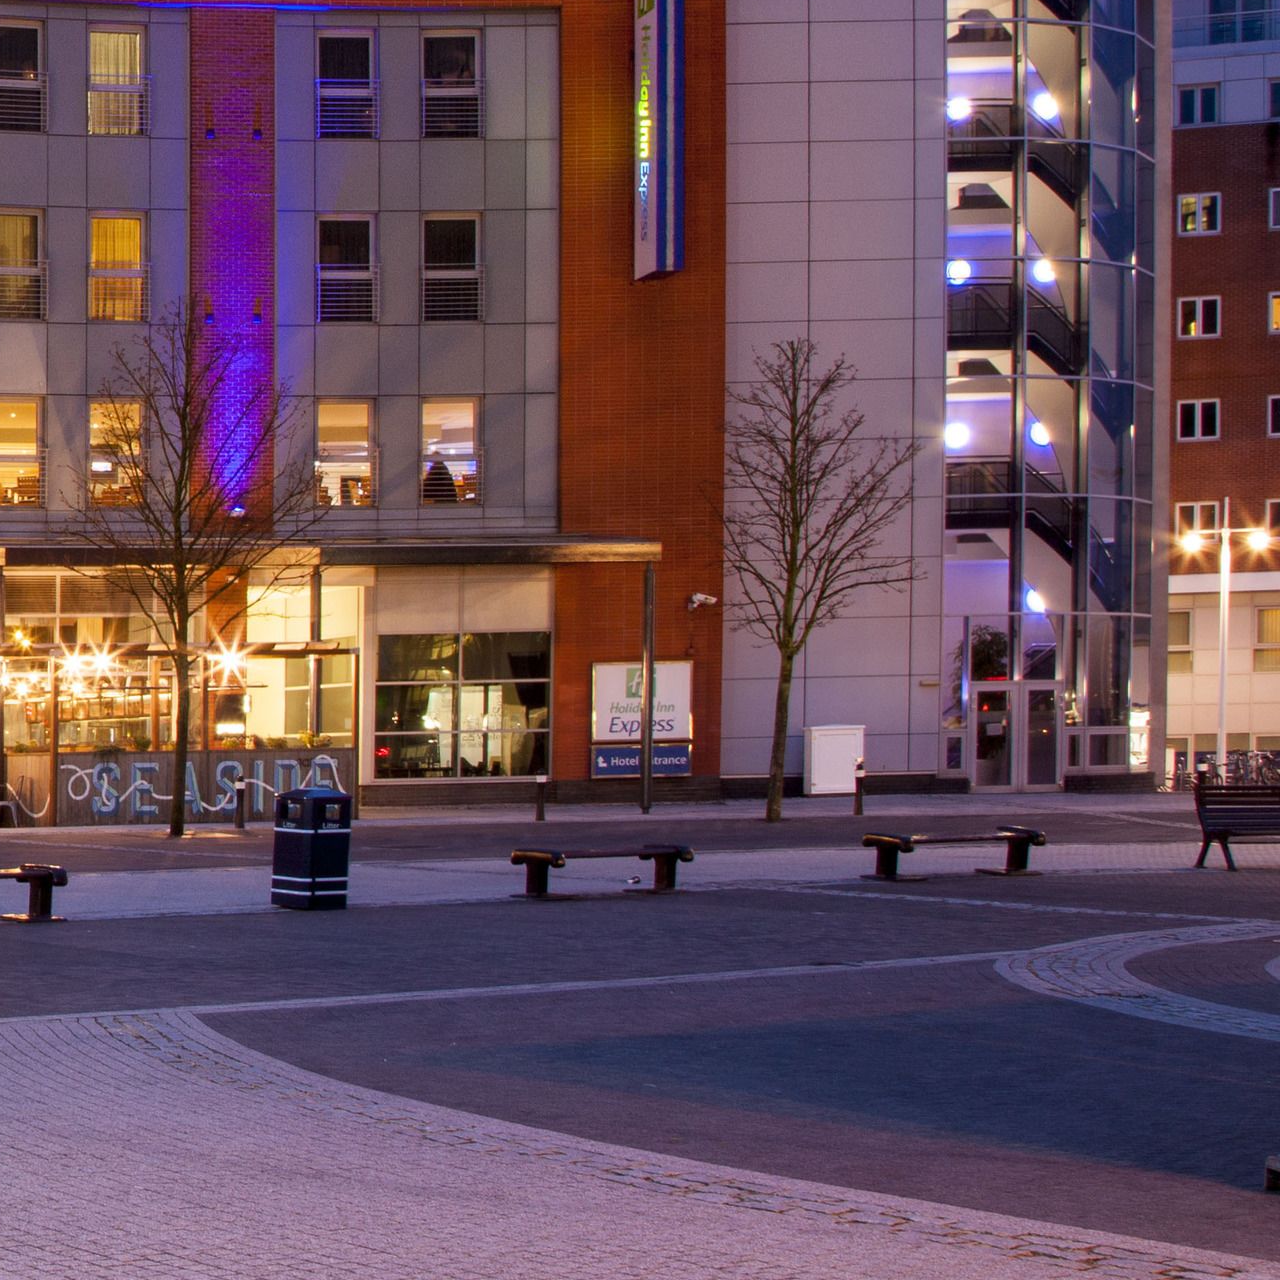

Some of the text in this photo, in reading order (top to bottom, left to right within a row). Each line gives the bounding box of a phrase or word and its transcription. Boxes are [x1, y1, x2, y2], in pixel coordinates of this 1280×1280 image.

[638, 24, 652, 242] Holiday Inn Express
[609, 701, 675, 715] Holid Inn
[608, 716, 675, 737] Expess
[610, 755, 688, 766] Hotel trance
